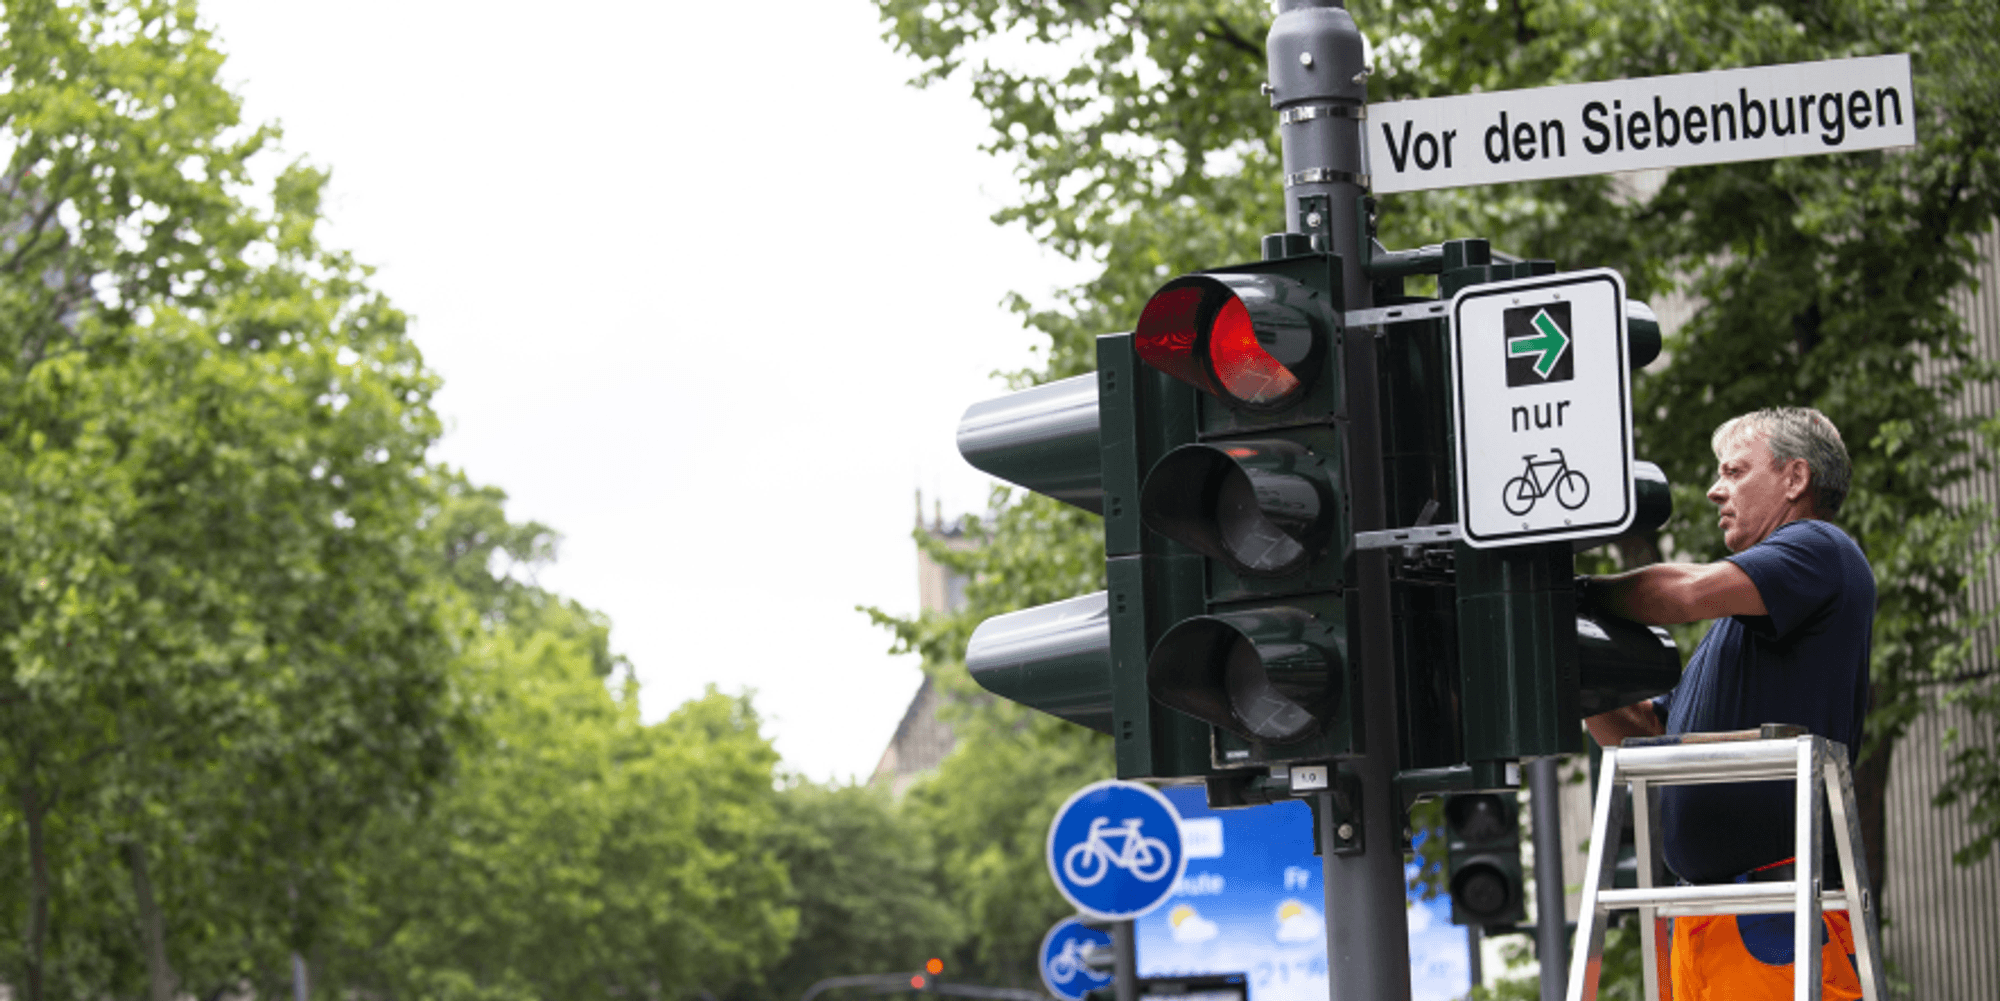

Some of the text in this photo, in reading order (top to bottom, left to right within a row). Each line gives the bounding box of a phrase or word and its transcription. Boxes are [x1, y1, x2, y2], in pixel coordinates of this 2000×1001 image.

[1382, 87, 1903, 172] Vor den Siebenburgen
[1512, 400, 1571, 432] nur
